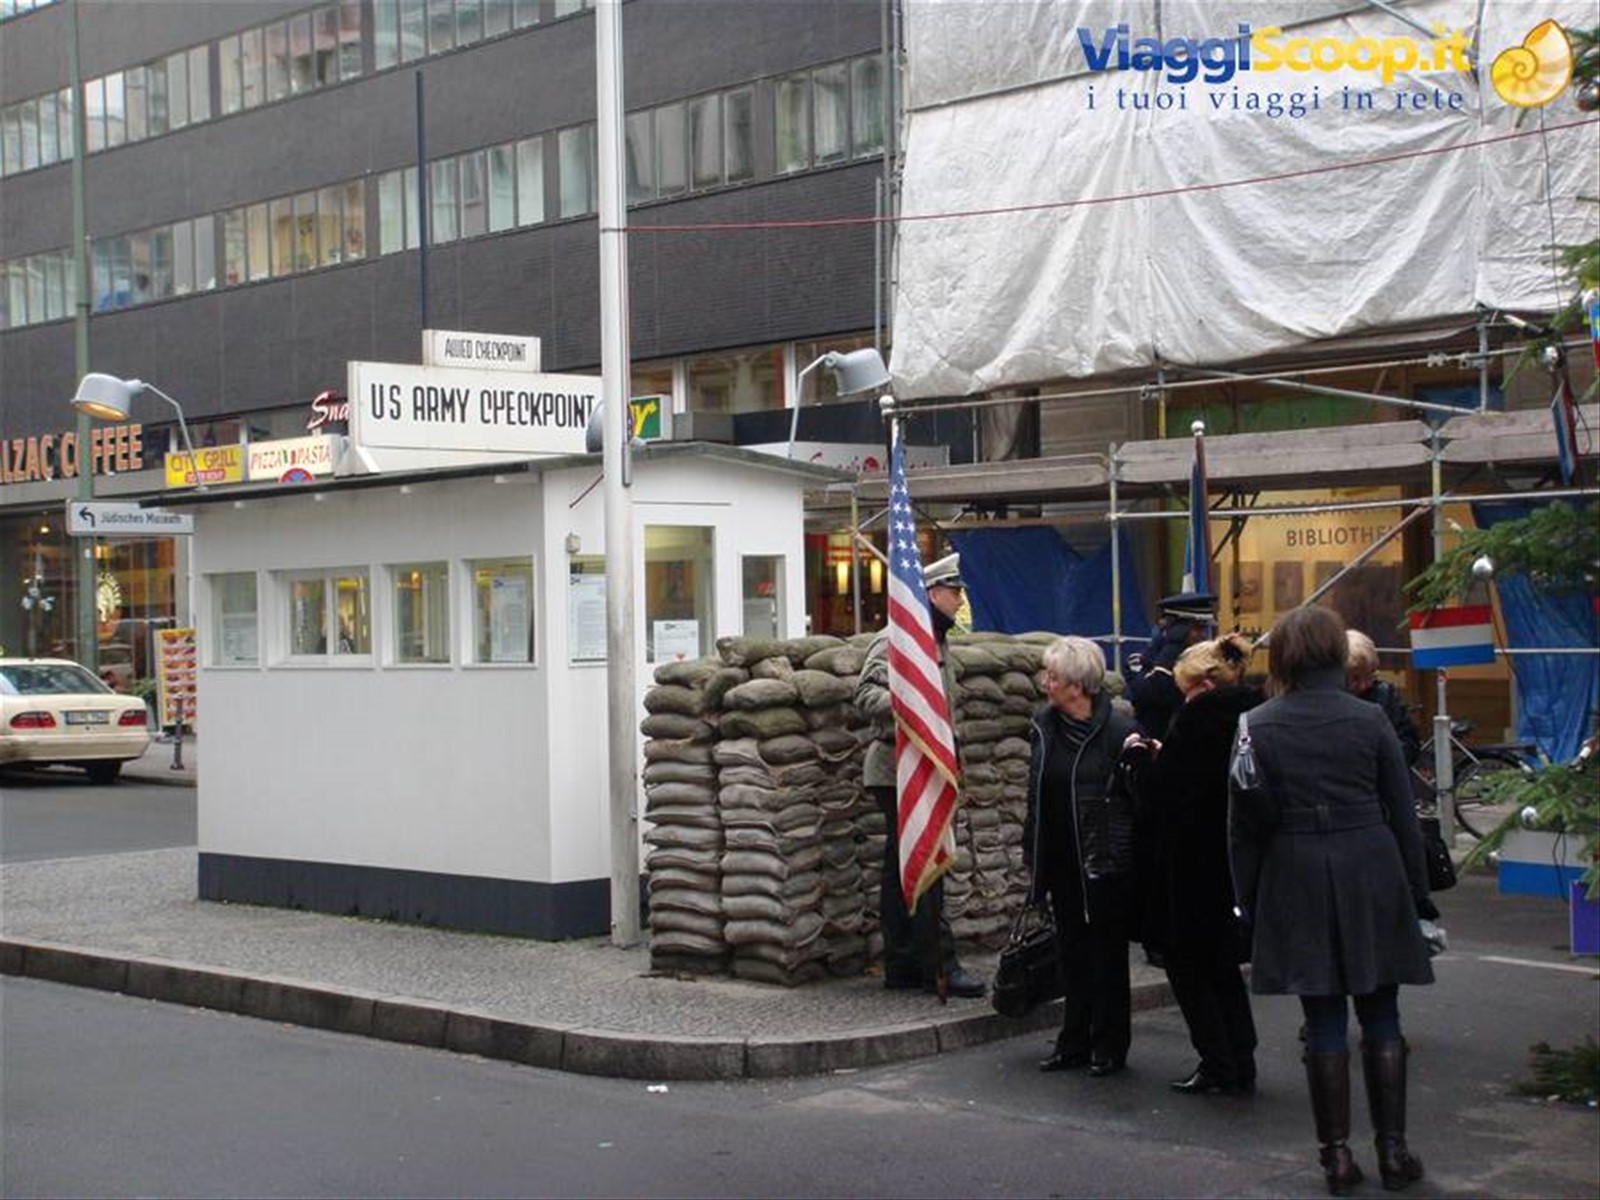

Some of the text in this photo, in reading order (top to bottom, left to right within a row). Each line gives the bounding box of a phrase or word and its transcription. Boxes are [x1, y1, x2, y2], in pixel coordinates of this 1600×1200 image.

[475, 341, 527, 362] CHECKPOINT
[412, 386, 470, 423] ARMY
[480, 389, 595, 429] CHECKPOINT
[0, 433, 54, 483] LZAC
[250, 444, 332, 469] PIZZA PASTA
